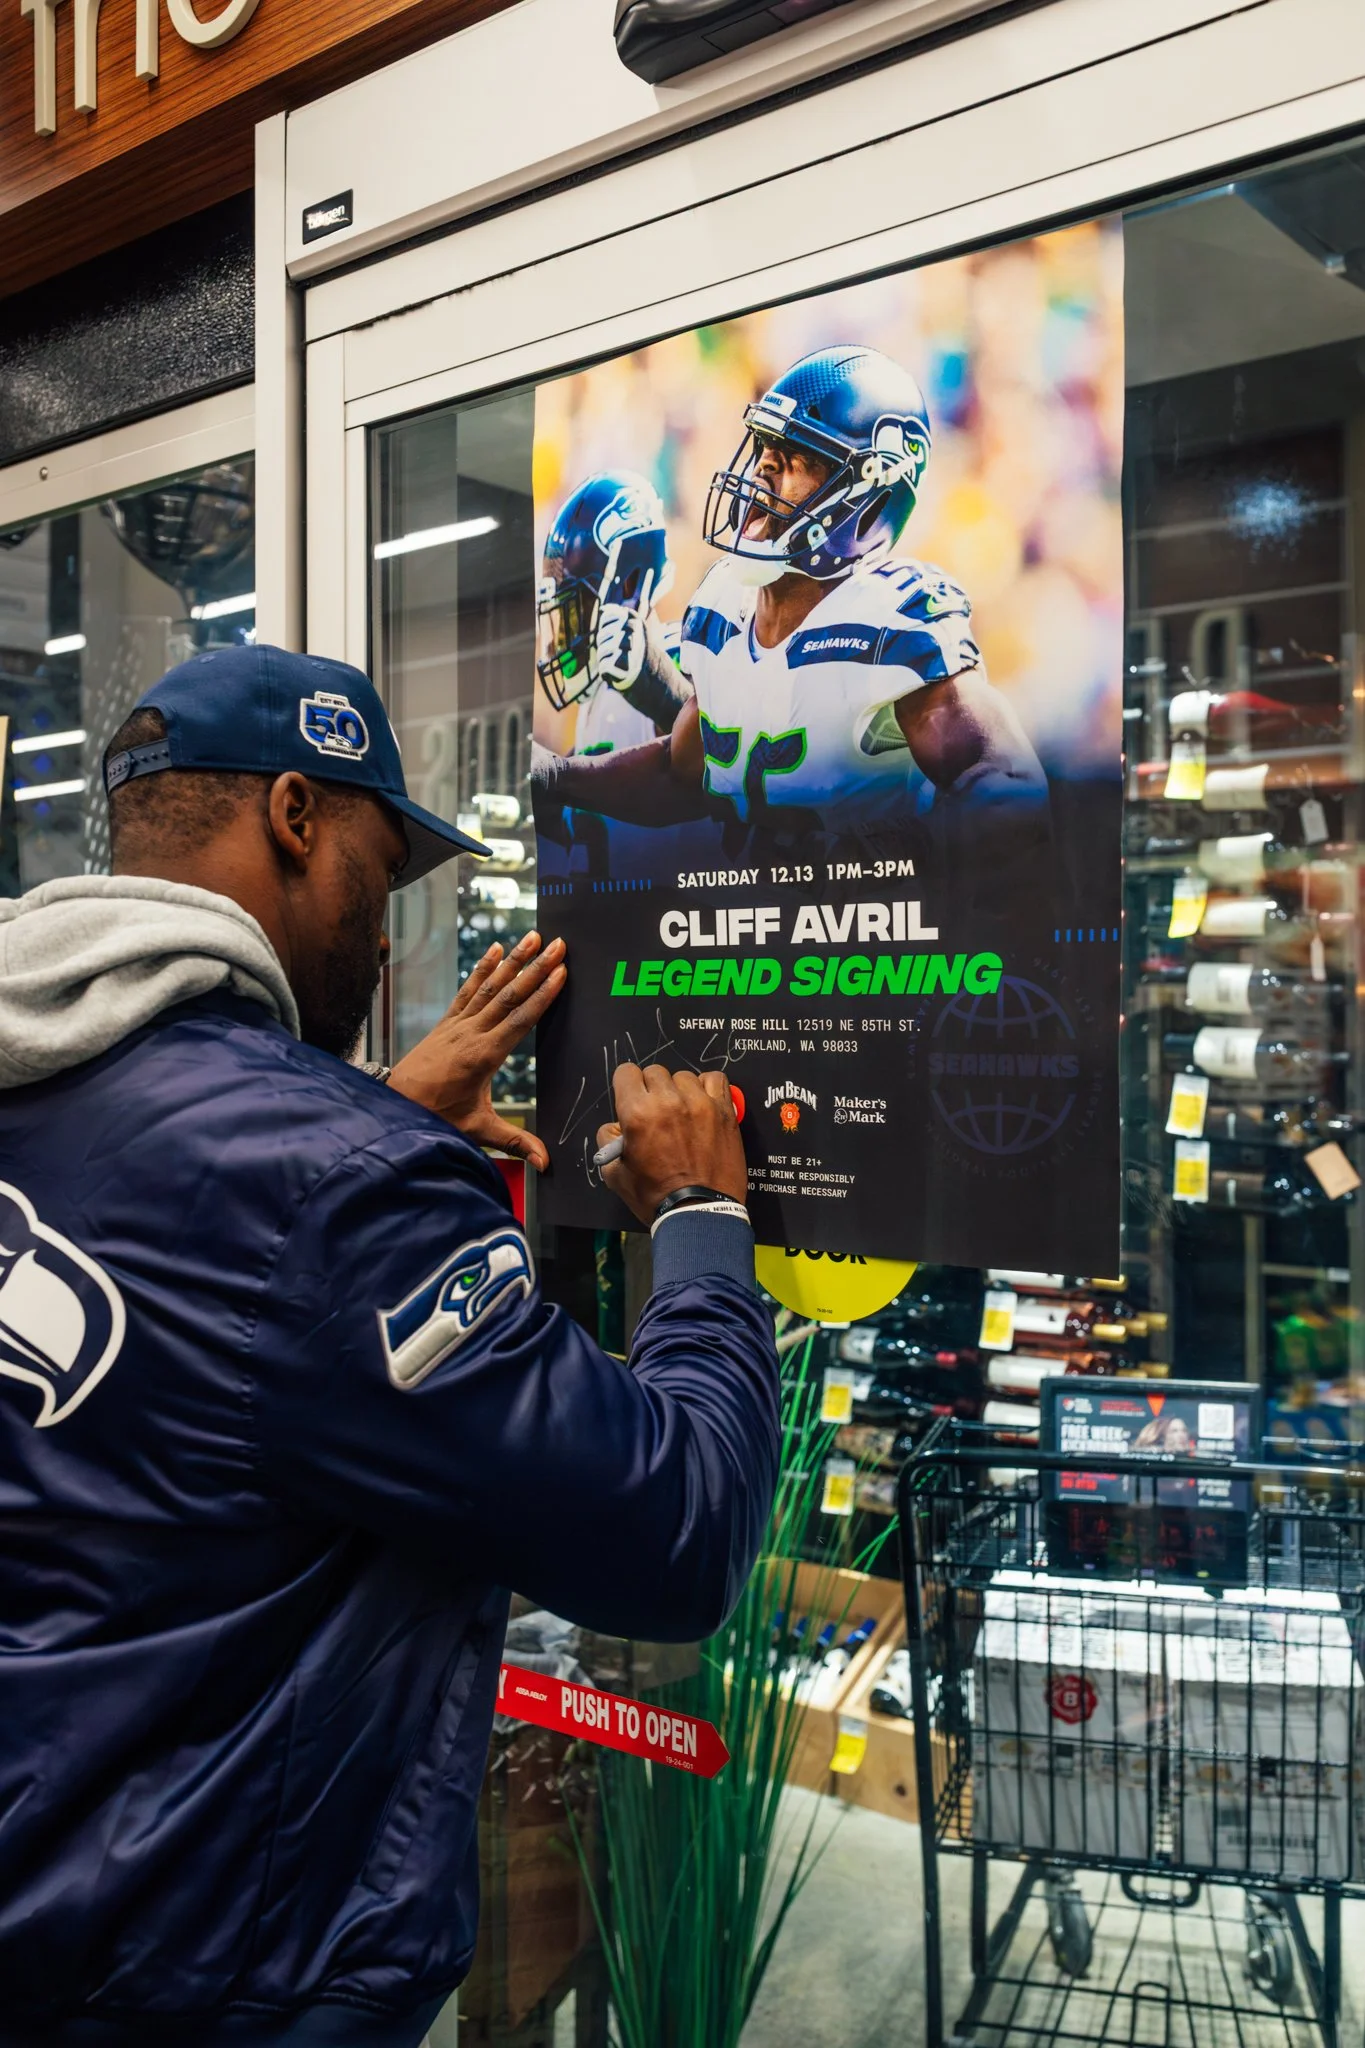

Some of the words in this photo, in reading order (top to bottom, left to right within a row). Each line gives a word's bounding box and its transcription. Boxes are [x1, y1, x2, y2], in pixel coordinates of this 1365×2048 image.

[800, 637, 871, 653] SEAHAWKS
[305, 703, 366, 750] 50
[677, 868, 760, 889] SATURDAY
[770, 865, 814, 883] 12.13
[826, 859, 915, 881] 1PM-3PM
[659, 906, 781, 949] CLIFF
[790, 900, 939, 944] AVRIL
[610, 958, 782, 998] LEGEND
[789, 951, 1003, 996] SIGNING
[679, 1018, 724, 1032] SAFEWAY
[731, 1018, 758, 1031] ROSE
[762, 1018, 790, 1031] HILL
[796, 1018, 833, 1031] 12519
[839, 1019, 854, 1032] NE
[861, 1018, 892, 1032] 85TH
[898, 1019, 921, 1032] ST.
[734, 1039, 791, 1053] KIRKLAND,
[800, 1039, 816, 1052] WA
[822, 1039, 858, 1053] 98033
[928, 1052, 1079, 1077] SEAHAWKS
[765, 1084, 785, 1109] JIM
[785, 1080, 818, 1111] BEAM
[833, 1095, 887, 1109] Maker's
[848, 1110, 886, 1124] Mark
[767, 1155, 787, 1165] MUST
[791, 1157, 802, 1165] BE
[806, 1158, 822, 1166] 21+
[747, 1168, 767, 1177] EASE
[770, 1170, 795, 1180] DRINK
[798, 1172, 856, 1184] RESPONSIBLY
[759, 1183, 797, 1195] PURCHASE
[801, 1186, 848, 1198] NECESSARY
[515, 1686, 530, 1698] ASSA
[530, 1691, 548, 1701] ABLOY
[561, 1686, 610, 1731] PUSH
[614, 1701, 640, 1739] TO
[645, 1711, 698, 1757] OPEN
[665, 1755, 694, 1770] 19-24-001
